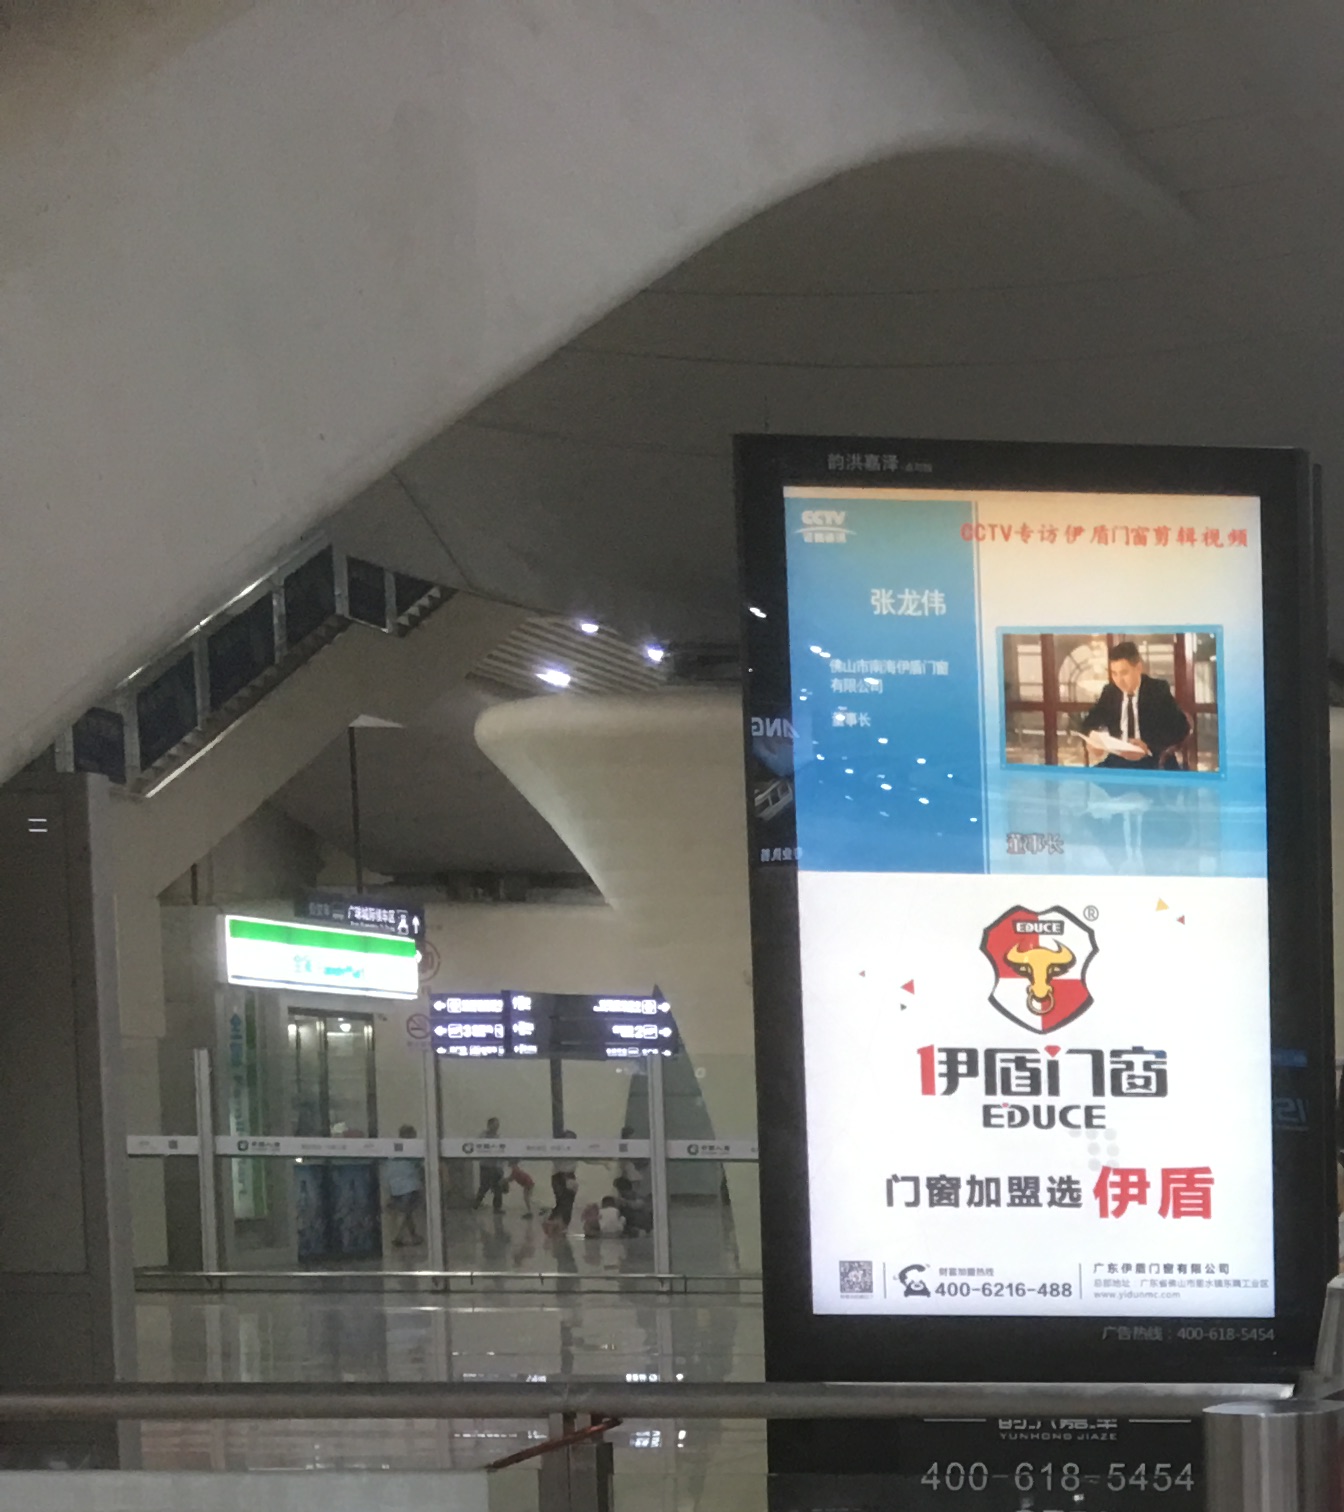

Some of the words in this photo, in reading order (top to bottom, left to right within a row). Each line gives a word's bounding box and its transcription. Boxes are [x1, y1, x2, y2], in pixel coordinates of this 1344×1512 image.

[801, 510, 846, 525] CCTV
[960, 521, 1249, 548] CCTV专访伊盾门窗剪辑视频
[870, 588, 947, 617] 张龙伟
[831, 677, 884, 694] 有限公司
[1006, 832, 1064, 855] 董事长
[1016, 922, 1061, 933] EDUCE
[917, 1045, 1168, 1098] 伊盾门窗
[982, 1103, 1106, 1130] EDUCE
[1094, 1263, 1230, 1275] 广东伊盾门窗有限公司
[935, 1282, 1073, 1298] 400-6216-488
[1094, 1290, 1181, 1300] www.yidunmc.com
[1000, 1432, 1072, 1440] YUNHONG
[1077, 1432, 1117, 1440] JIAZE
[920, 1462, 1195, 1491] 400-618-5454
